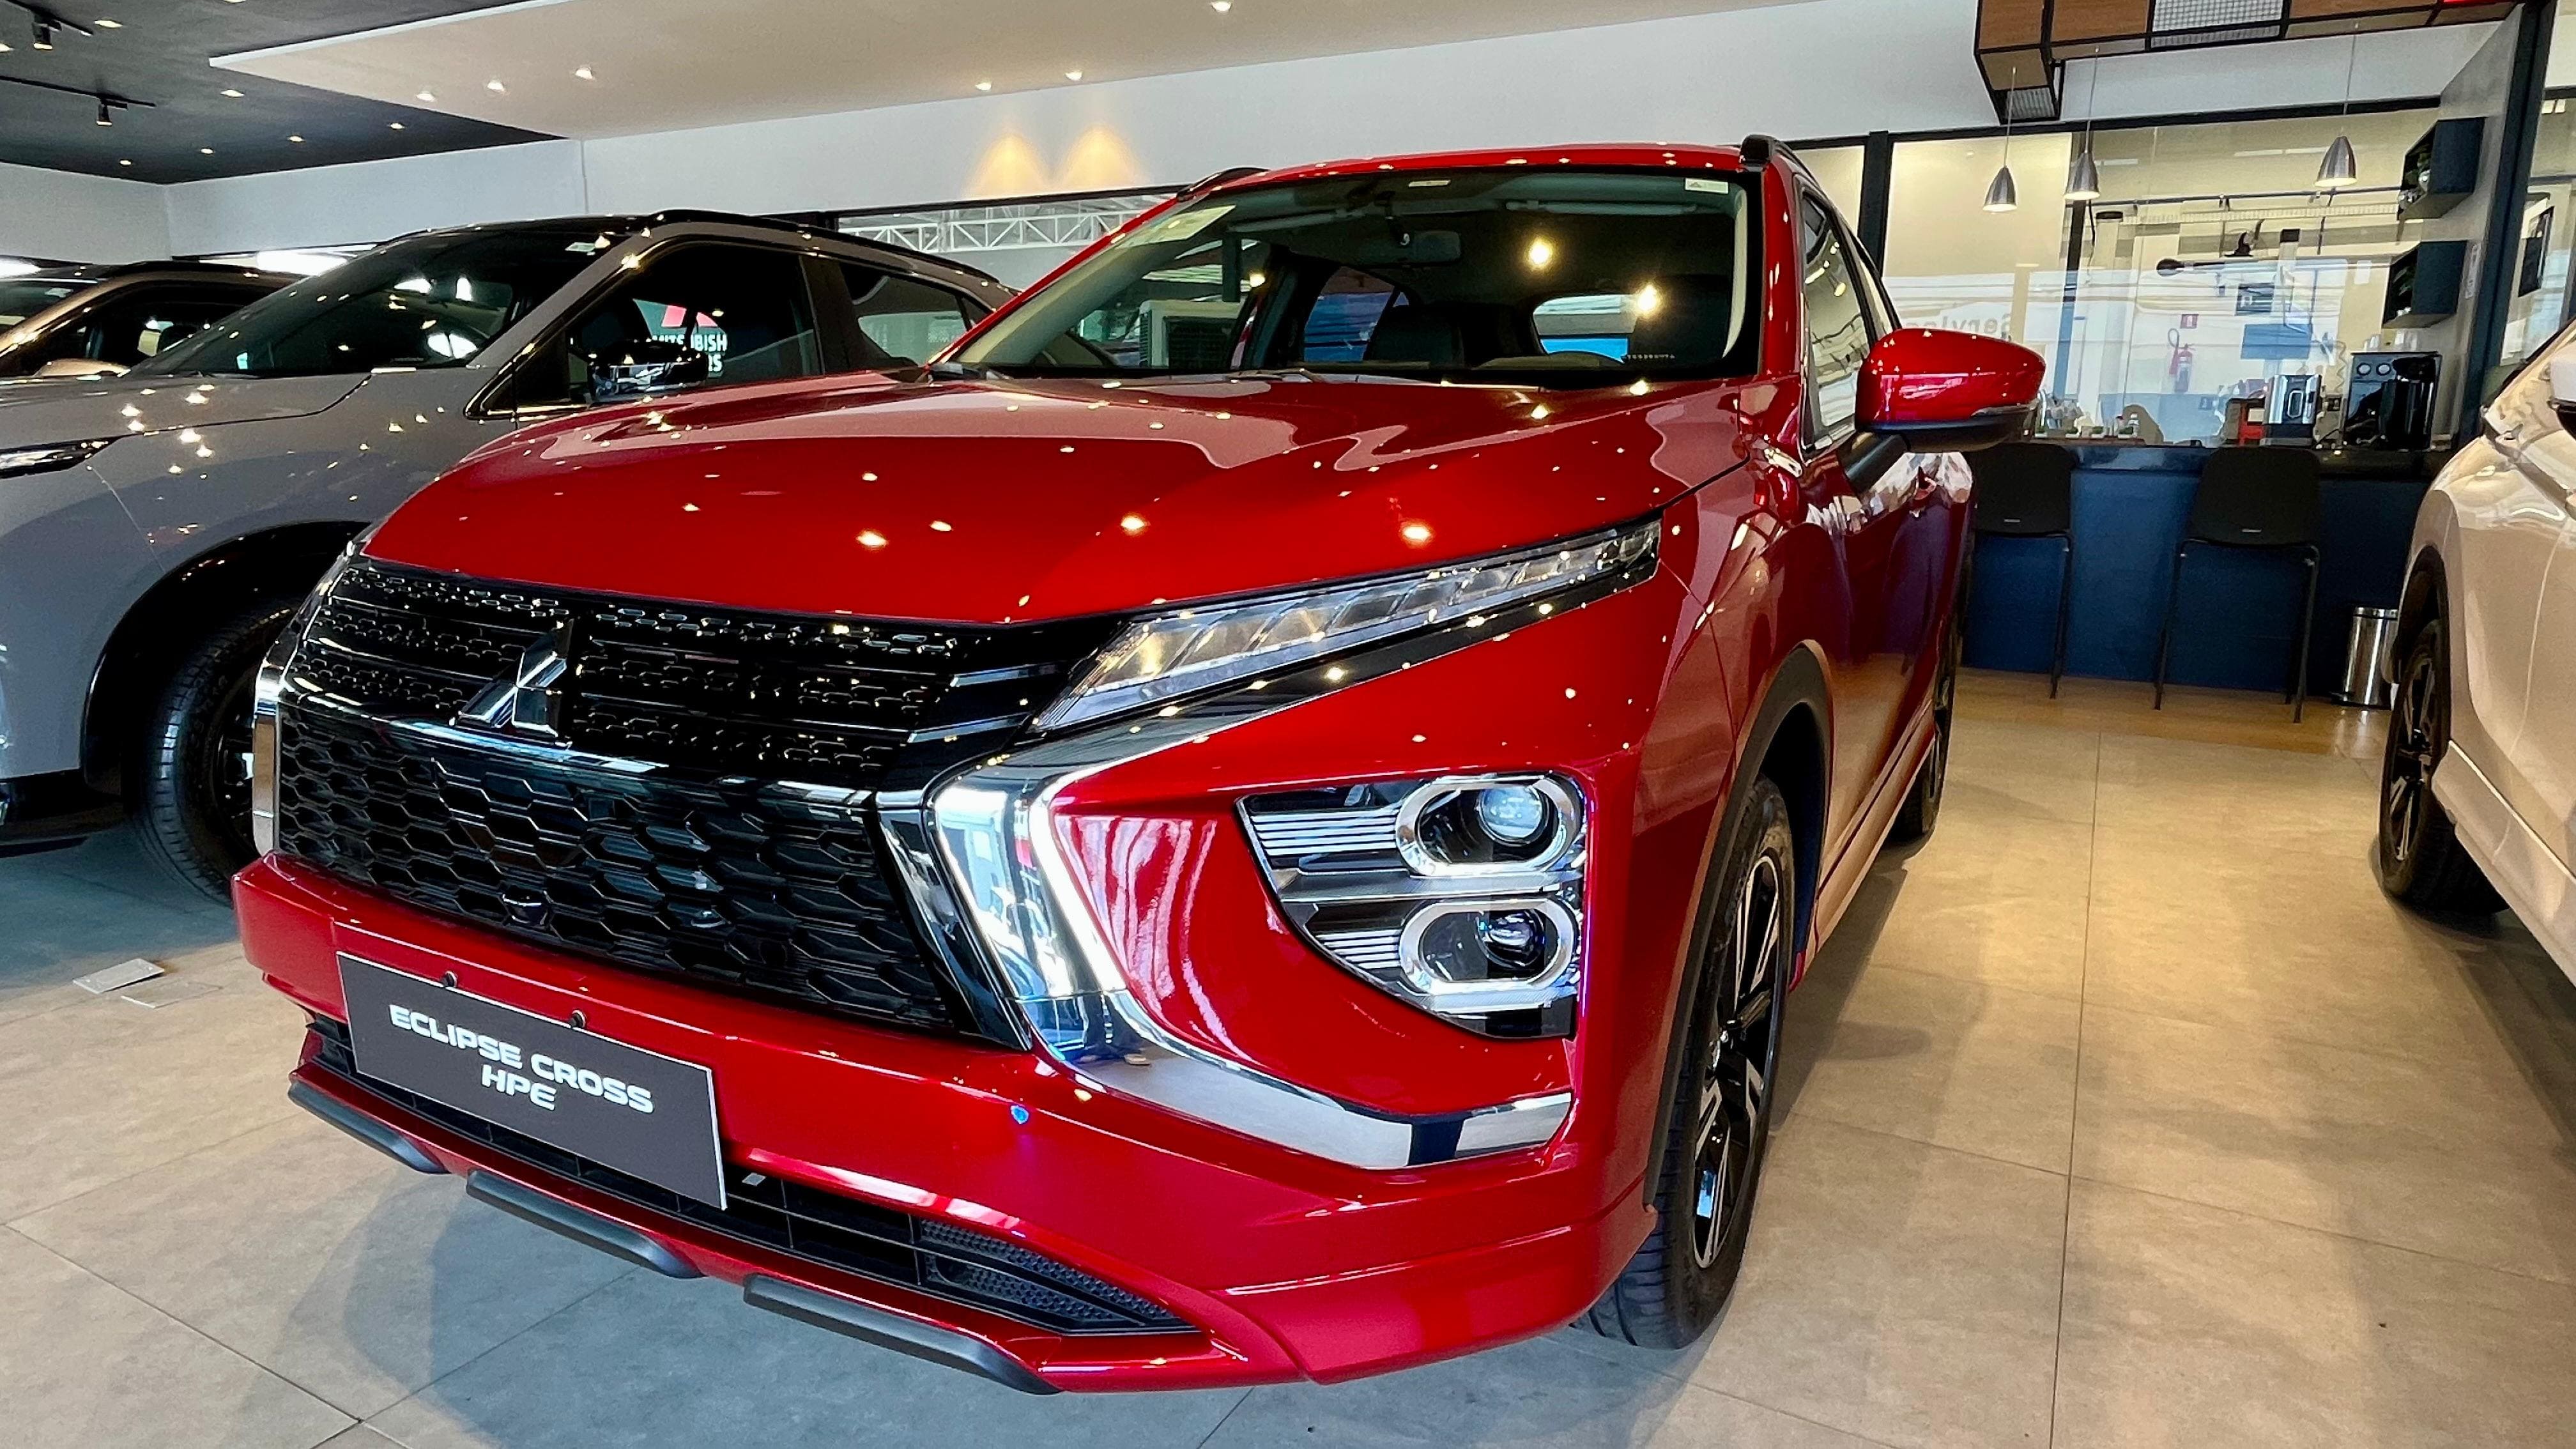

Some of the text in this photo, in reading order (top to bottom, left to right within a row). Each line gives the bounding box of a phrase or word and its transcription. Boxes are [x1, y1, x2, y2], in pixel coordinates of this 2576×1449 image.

[389, 1004, 654, 1113] ECLIPSE CROSS
[482, 1064, 557, 1110] HPE
